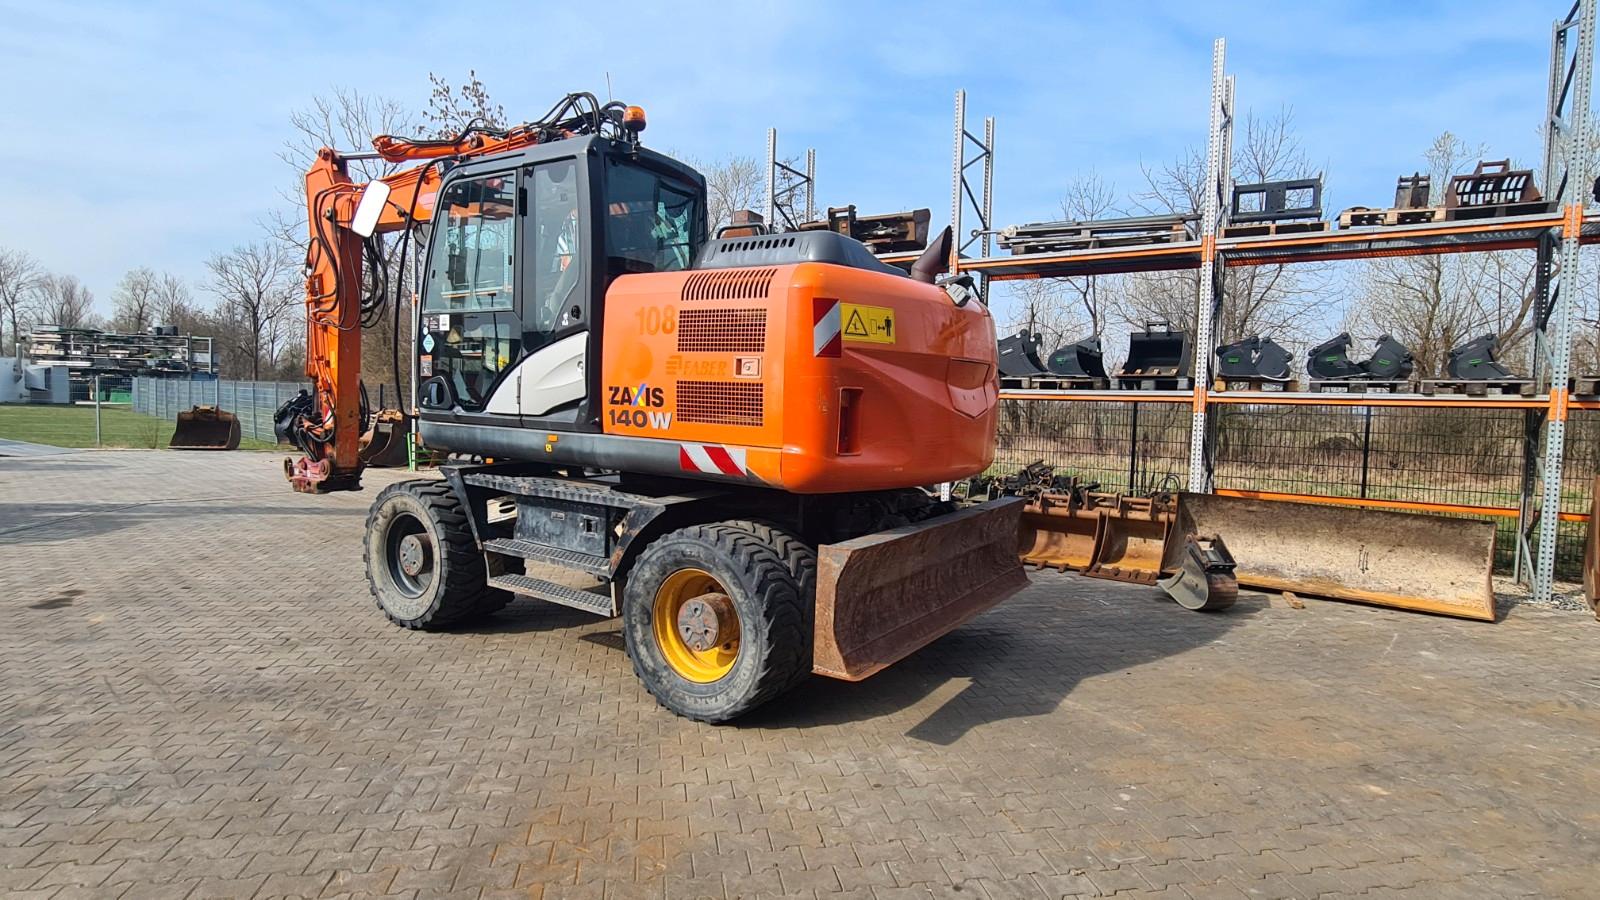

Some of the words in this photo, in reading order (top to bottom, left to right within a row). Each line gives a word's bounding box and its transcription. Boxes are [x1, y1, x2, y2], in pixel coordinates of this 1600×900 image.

[635, 305, 676, 336] 108
[682, 360, 728, 376] FABER
[608, 384, 664, 408] ZAXIS
[609, 409, 672, 430] 140W
